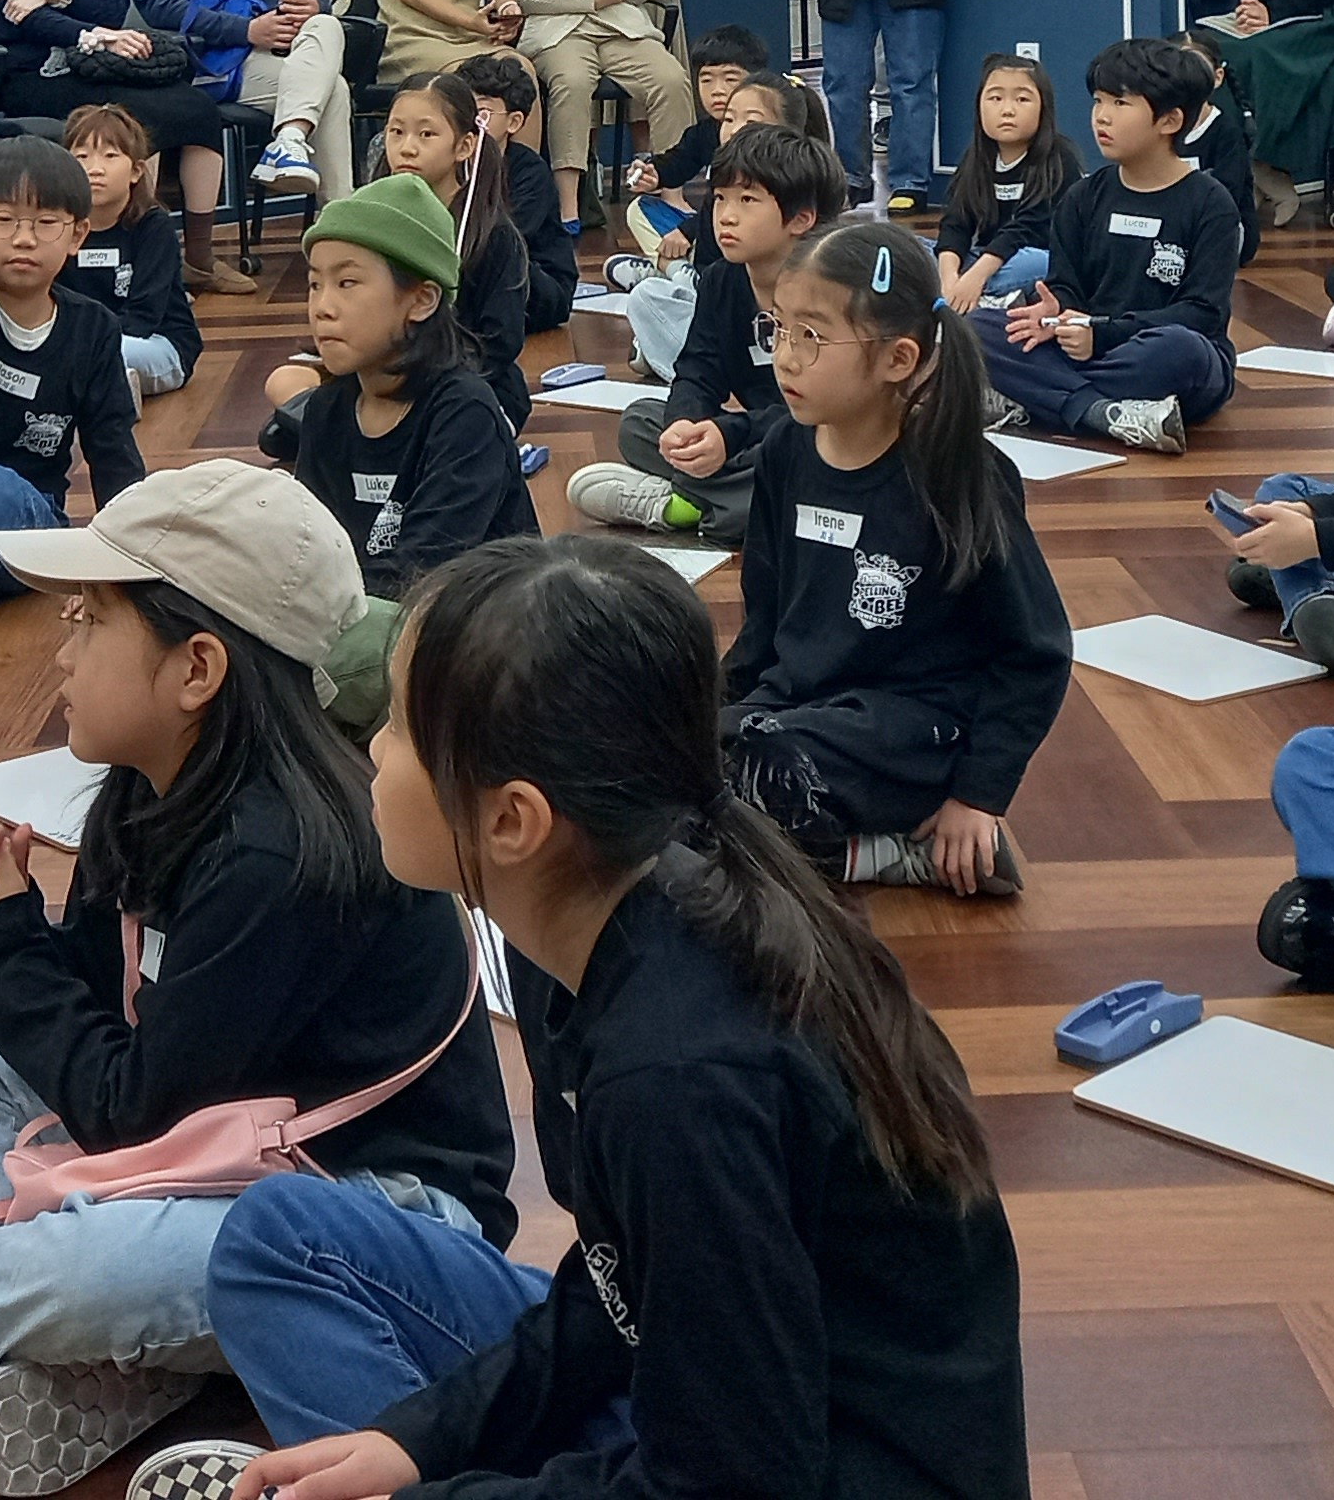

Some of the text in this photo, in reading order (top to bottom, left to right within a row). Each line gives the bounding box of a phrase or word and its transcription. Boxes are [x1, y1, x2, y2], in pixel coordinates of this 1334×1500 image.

[364, 477, 389, 491] Luke
[813, 511, 845, 530] Irene
[853, 583, 898, 600] SPELLING
[874, 599, 904, 615] BEE
